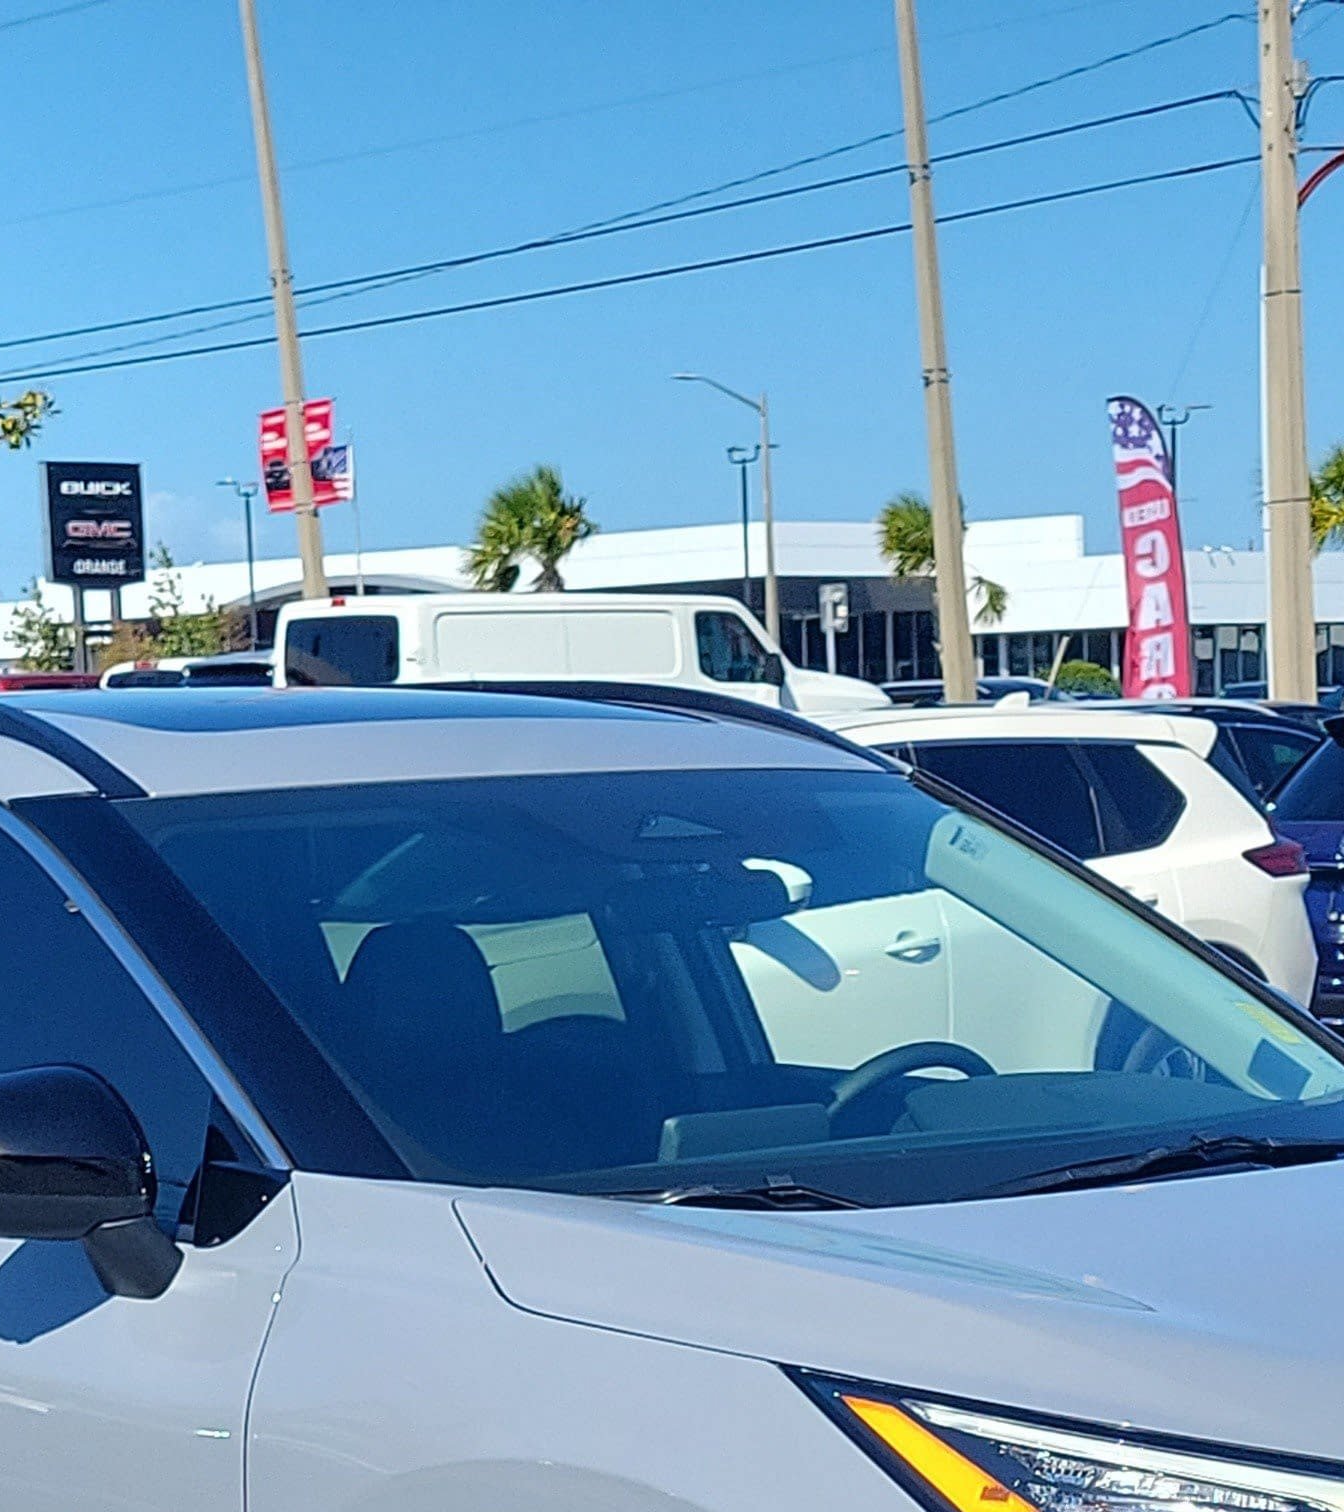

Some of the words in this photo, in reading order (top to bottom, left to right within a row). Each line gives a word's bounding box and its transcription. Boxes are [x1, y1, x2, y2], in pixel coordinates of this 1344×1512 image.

[59, 481, 133, 495] BUICK
[65, 520, 132, 538] GMC
[73, 558, 127, 575] ORANGE
